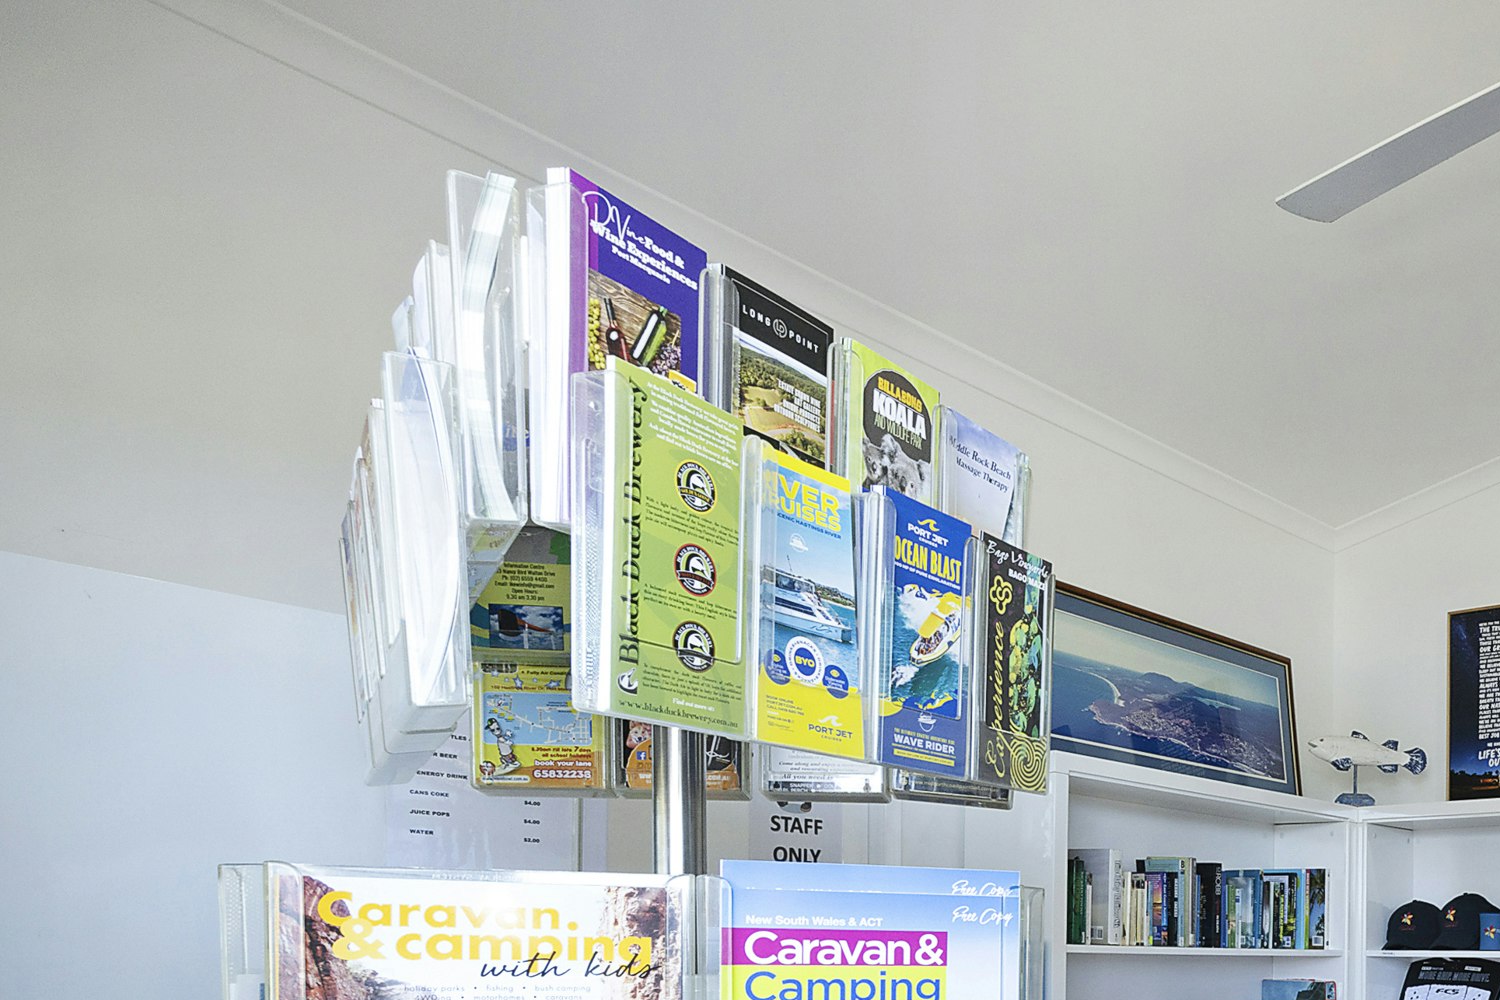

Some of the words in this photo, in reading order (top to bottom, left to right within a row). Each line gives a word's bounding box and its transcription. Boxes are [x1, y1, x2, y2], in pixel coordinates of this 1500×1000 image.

[590, 220, 625, 248] Wine
[627, 241, 698, 290] Experiences
[742, 304, 771, 327] LONG
[789, 331, 819, 353] POINT
[878, 377, 922, 412] BILLABONG
[873, 388, 927, 439] KOALA
[622, 377, 648, 503] Brewery
[874, 413, 886, 430] AND
[886, 418, 910, 444] WILDLIFE
[910, 430, 922, 450] PARK
[956, 457, 981, 479] Massage
[983, 472, 1008, 493] Therapy
[971, 451, 989, 468] Rock
[991, 461, 1011, 480] Beach
[622, 505, 640, 581] Duck
[895, 535, 928, 571] OCEAN
[930, 550, 961, 583] BLAST
[619, 585, 639, 665] Black
[795, 656, 815, 667] BYO
[808, 724, 833, 734] PORT
[836, 729, 853, 739] JET
[894, 734, 924, 747] WAVE
[925, 741, 955, 754] RIDER
[1478, 748, 1500, 760] LIFE'S
[533, 770, 591, 779] 65832238
[770, 815, 823, 836] STAFF
[773, 846, 820, 863] ONLY
[317, 890, 559, 929] Caravan
[745, 915, 772, 925] New
[775, 915, 810, 925] South
[813, 916, 845, 926] Wales
[848, 917, 857, 926] &
[859, 917, 882, 927] ACT
[332, 919, 386, 961] &
[396, 919, 652, 973] camping
[744, 931, 912, 965] Caravan
[914, 933, 944, 965] &
[481, 952, 569, 979] with
[583, 952, 661, 978] kids
[1435, 987, 1459, 996] FCS
